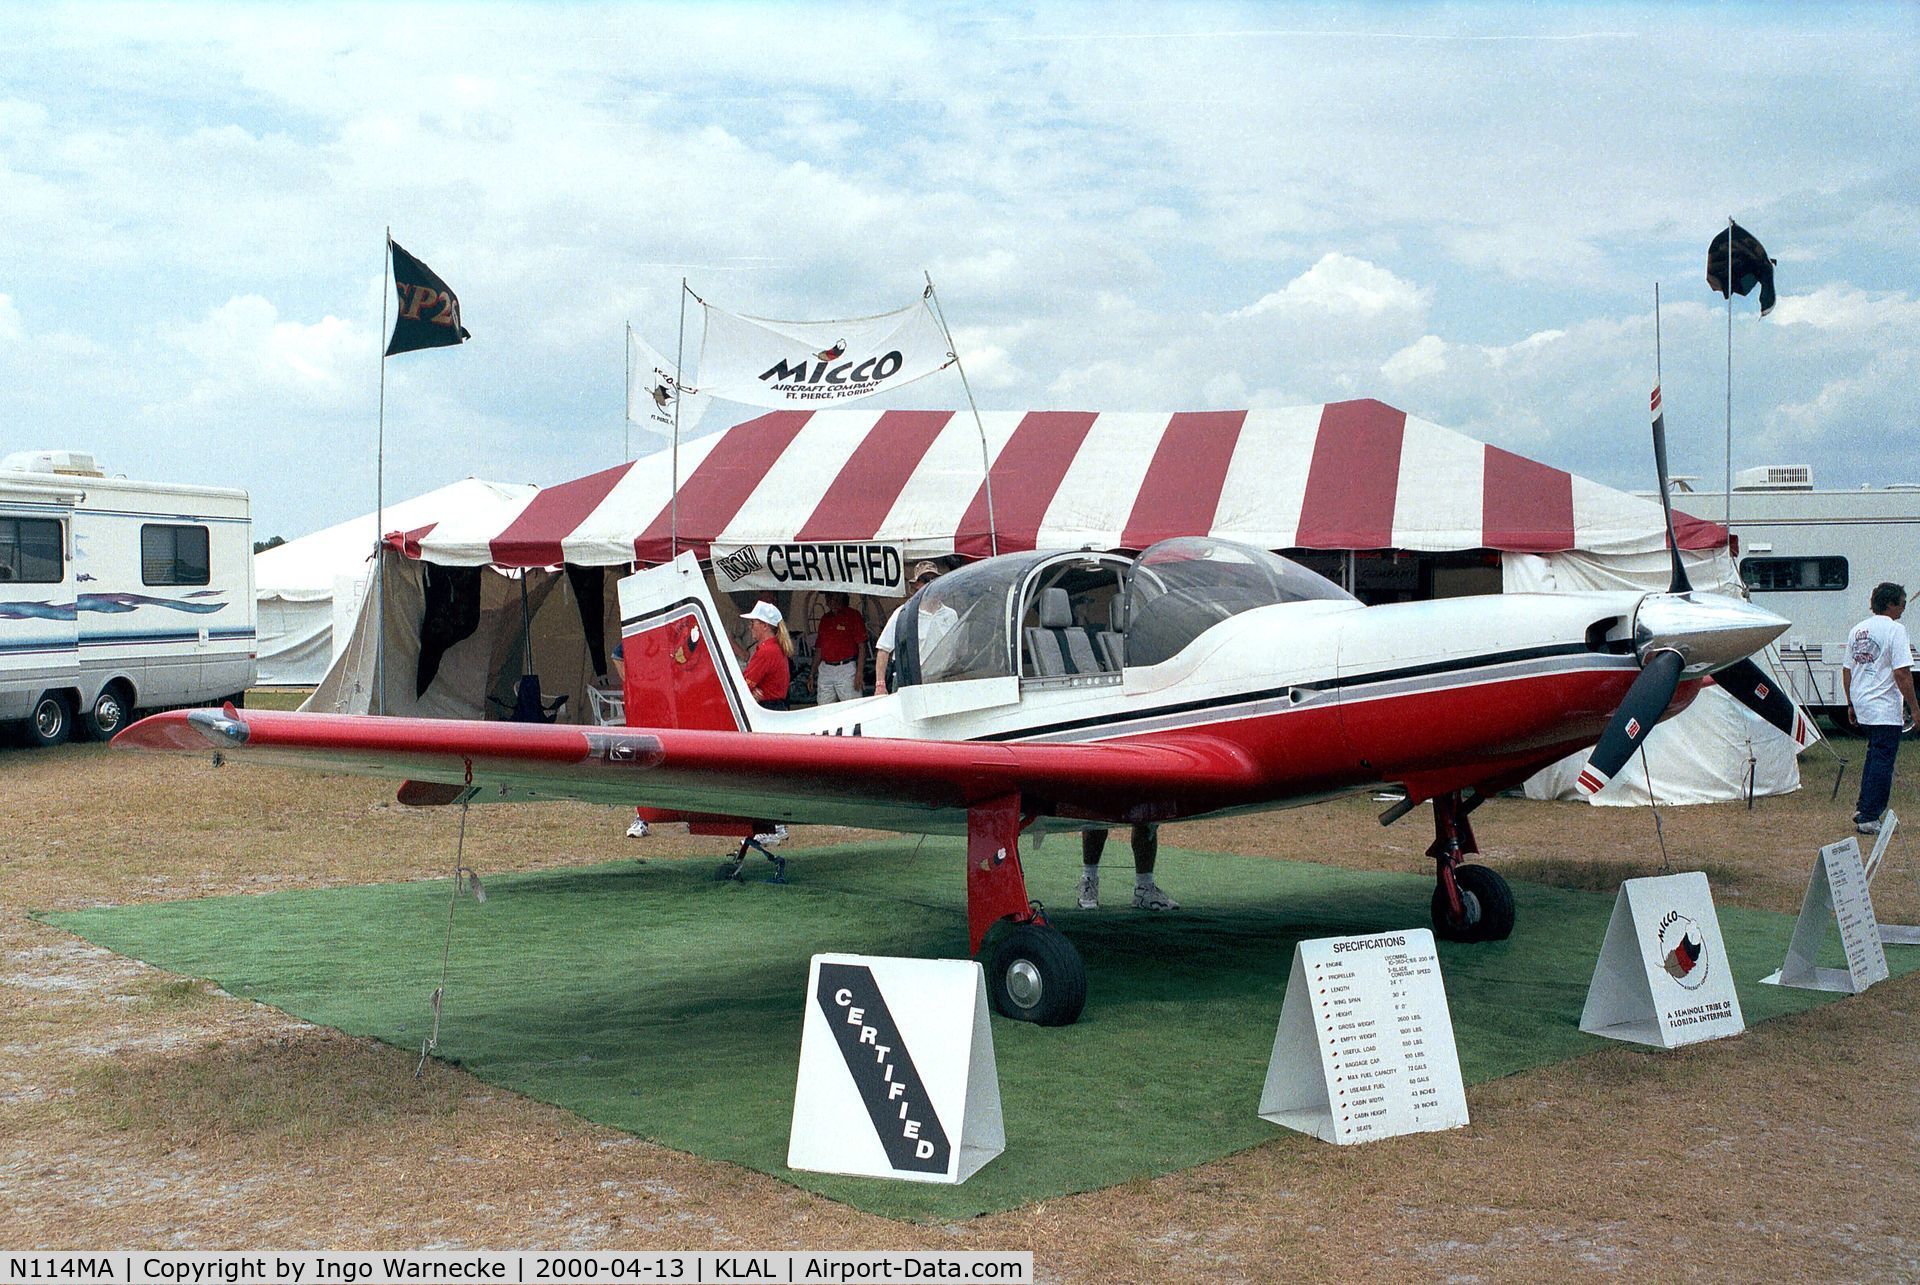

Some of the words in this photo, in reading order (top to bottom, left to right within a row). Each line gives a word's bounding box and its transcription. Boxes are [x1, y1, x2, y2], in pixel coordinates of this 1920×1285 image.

[758, 350, 903, 384] MICCO
[654, 367, 674, 384] ICCO
[770, 383, 826, 392] AIRCRAFT
[827, 380, 882, 391] COMPANY
[801, 392, 834, 400] PIERCE,
[837, 387, 874, 398] FLORIDA
[720, 546, 761, 580] NOW
[766, 544, 901, 587] CERTIFIED
[1658, 911, 1679, 942] MICCO
[1333, 936, 1406, 953] SPECIFICATIONS
[1328, 972, 1355, 980] PROPELLER
[1391, 970, 1415, 978] CONSTANT
[1330, 985, 1350, 993] LENGTH
[1674, 1005, 1704, 1018] SEMINOLE
[1705, 1002, 1722, 1012] TRIBE
[1723, 1000, 1731, 1009] OF
[1670, 1017, 1698, 1028] FLORIDA
[1700, 1010, 1732, 1022] ENTERPRISE
[1338, 1022, 1356, 1030] GROSS
[1357, 1020, 1375, 1028] WEIGHT
[1359, 1032, 1377, 1040] WEIGHT
[1345, 1059, 1368, 1068] BAGGAGE
[835, 988, 935, 1159] CERTIFIED
[1374, 1068, 1397, 1077] CAPACITY
[1349, 1084, 1371, 1093] USEABLE
[1420, 1087, 1436, 1096] INCHES
[1369, 1096, 1385, 1104] WIDTH
[1421, 1100, 1438, 1108] INCHES
[1370, 1108, 1387, 1117] HEIGHT
[1356, 1124, 1372, 1132] SEATS
